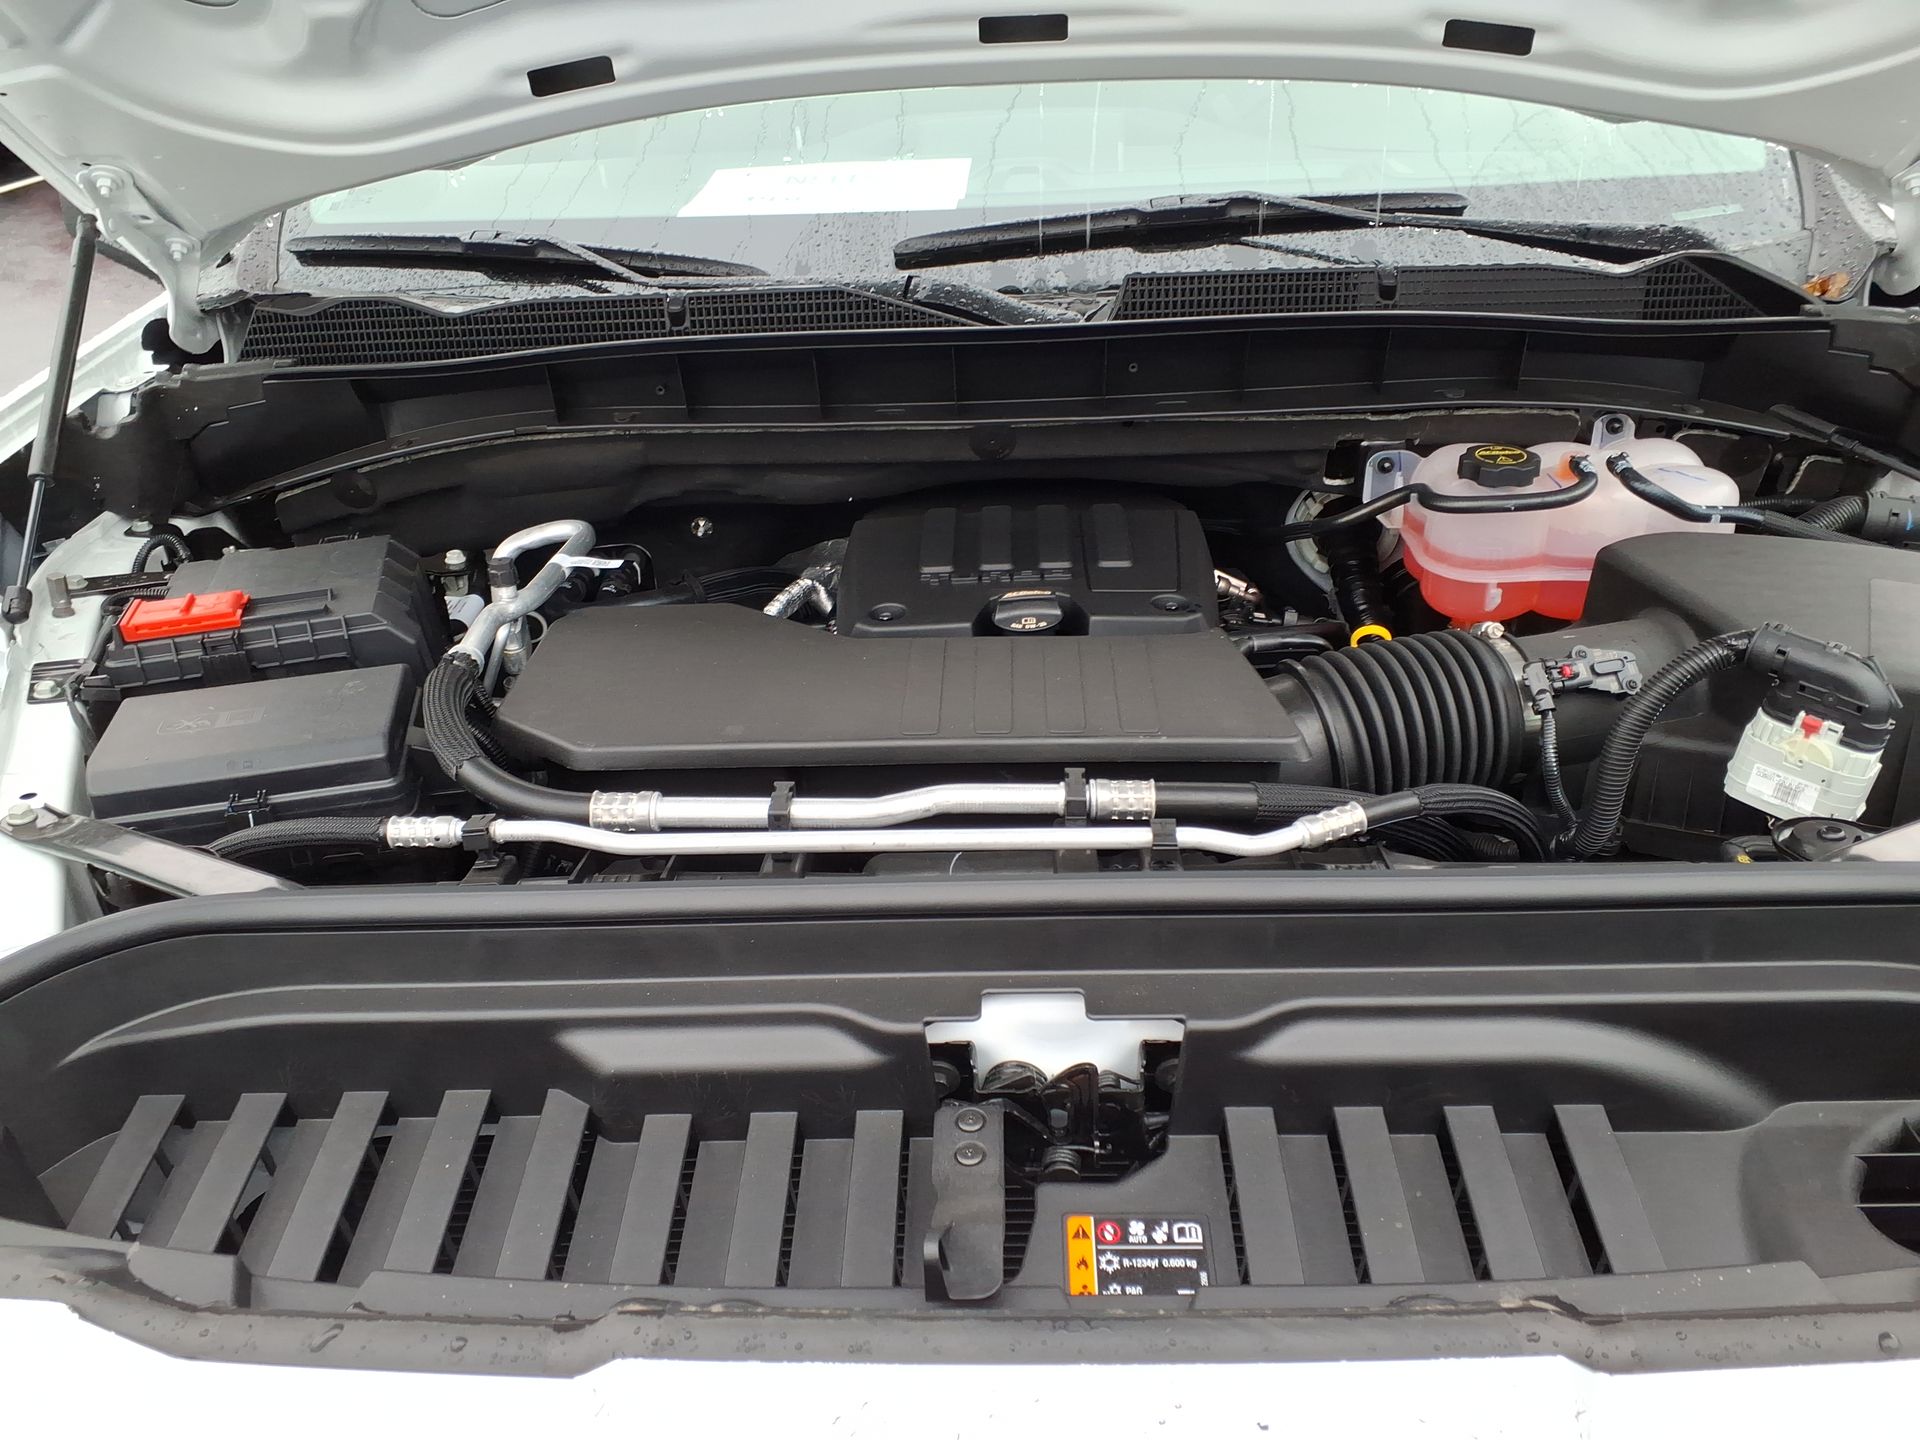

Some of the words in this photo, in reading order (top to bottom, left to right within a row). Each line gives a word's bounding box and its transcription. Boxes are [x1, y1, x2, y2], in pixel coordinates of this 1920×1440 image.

[1128, 1236, 1148, 1244] AUTO
[1122, 1257, 1159, 1269] R-1234yf
[1186, 1257, 1198, 1269] kg
